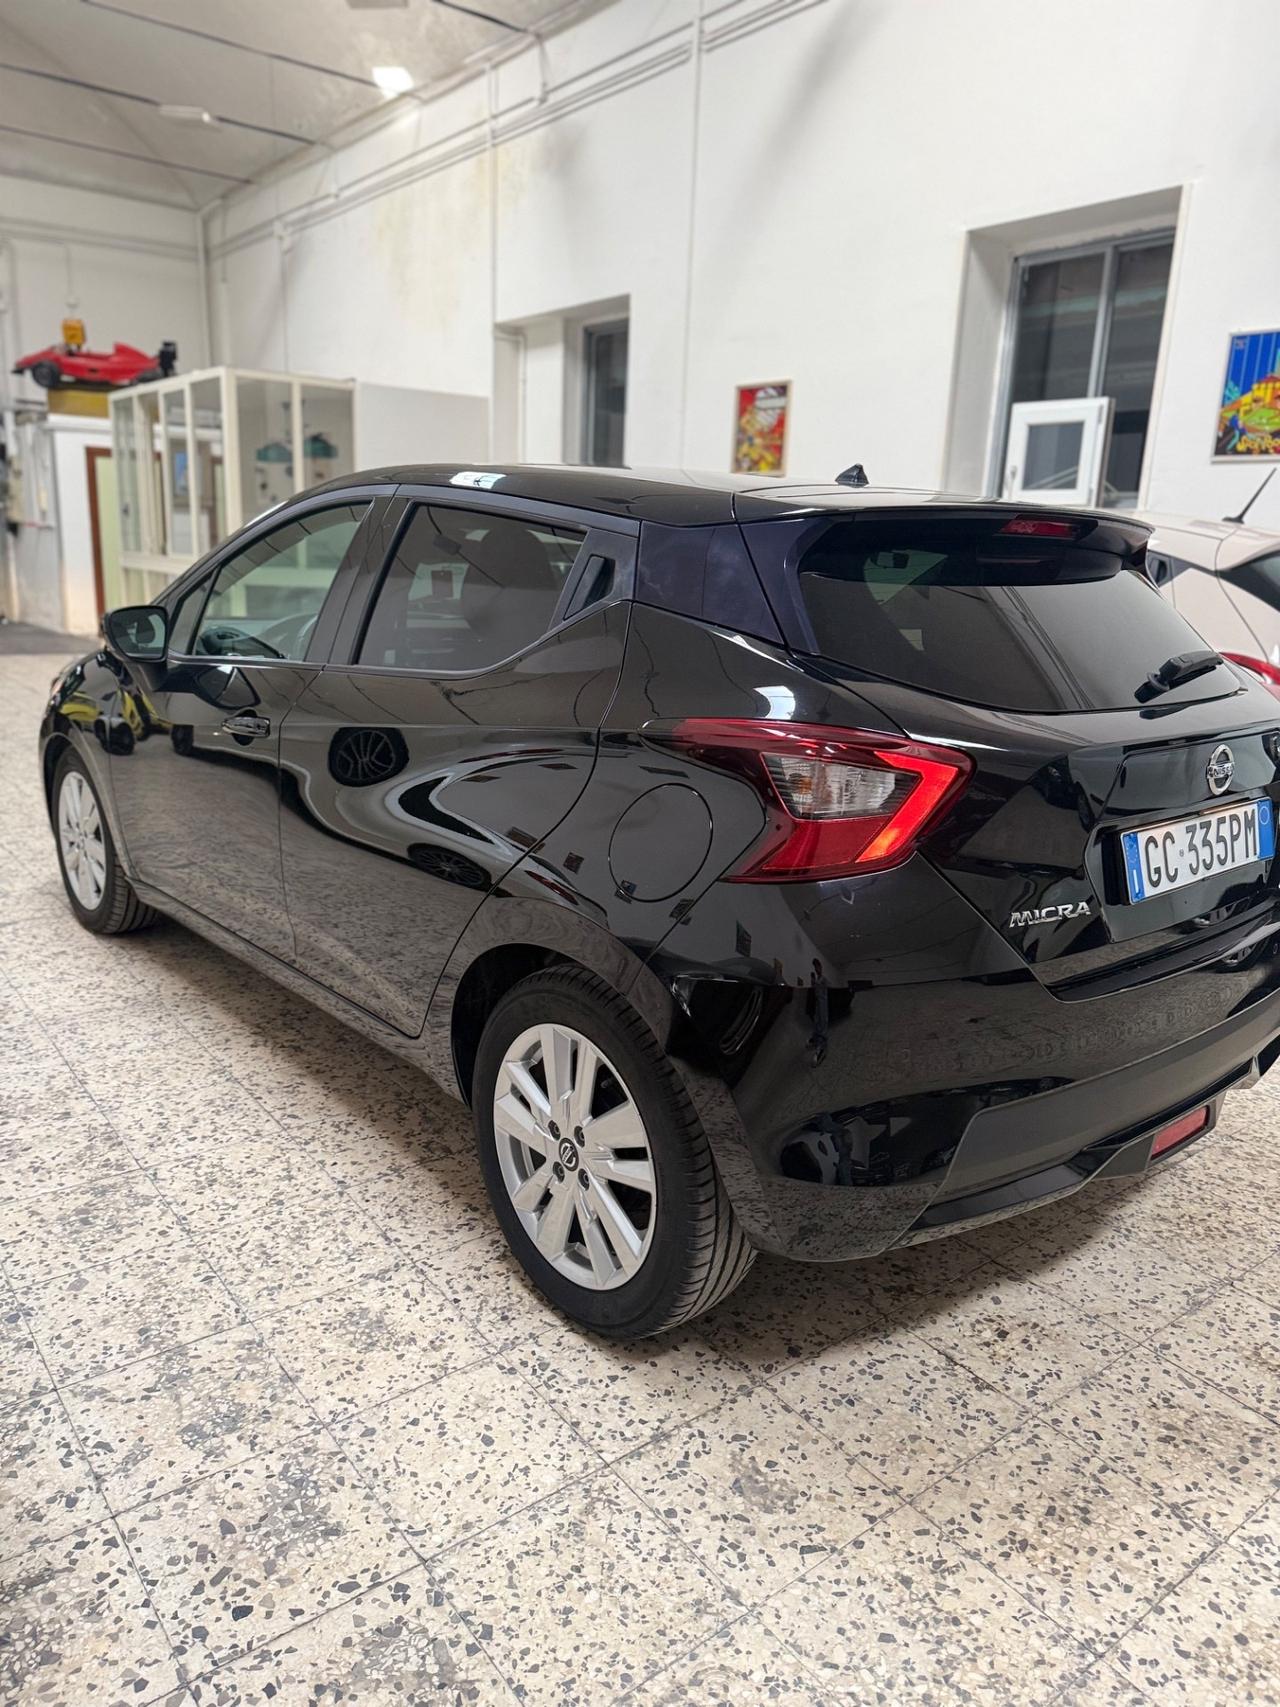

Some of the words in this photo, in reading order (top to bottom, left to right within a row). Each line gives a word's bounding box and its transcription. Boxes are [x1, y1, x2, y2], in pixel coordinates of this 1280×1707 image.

[1145, 831, 1179, 888] GC
[1185, 809, 1258, 876] 335PM
[1009, 901, 1092, 928] MICRA
